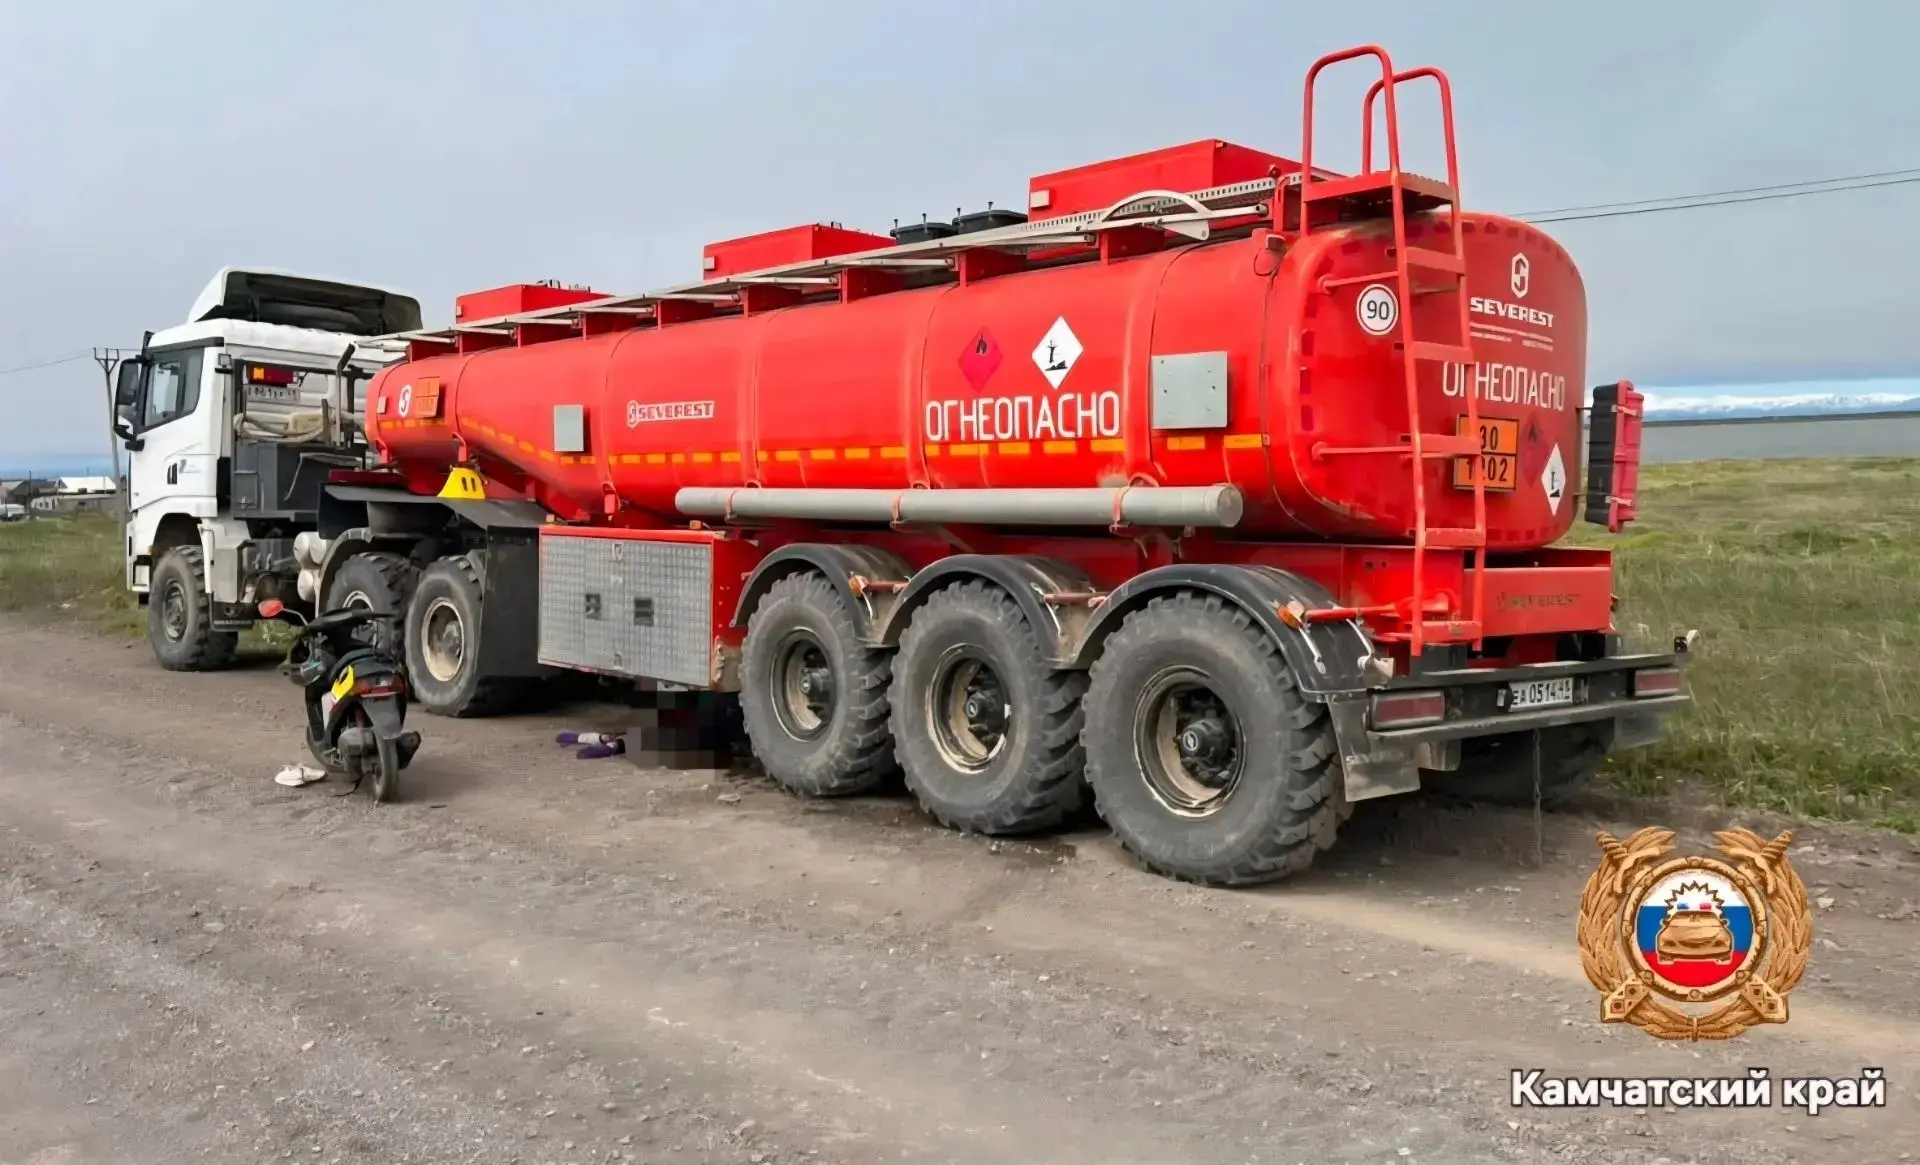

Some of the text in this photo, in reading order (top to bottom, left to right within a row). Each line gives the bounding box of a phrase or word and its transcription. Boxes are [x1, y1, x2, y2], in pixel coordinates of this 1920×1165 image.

[1367, 300, 1389, 320] 90
[1470, 296, 1554, 328] SEVEREST
[925, 391, 1120, 441] ОГНЕОПАСНО
[1480, 425, 1498, 450] 30
